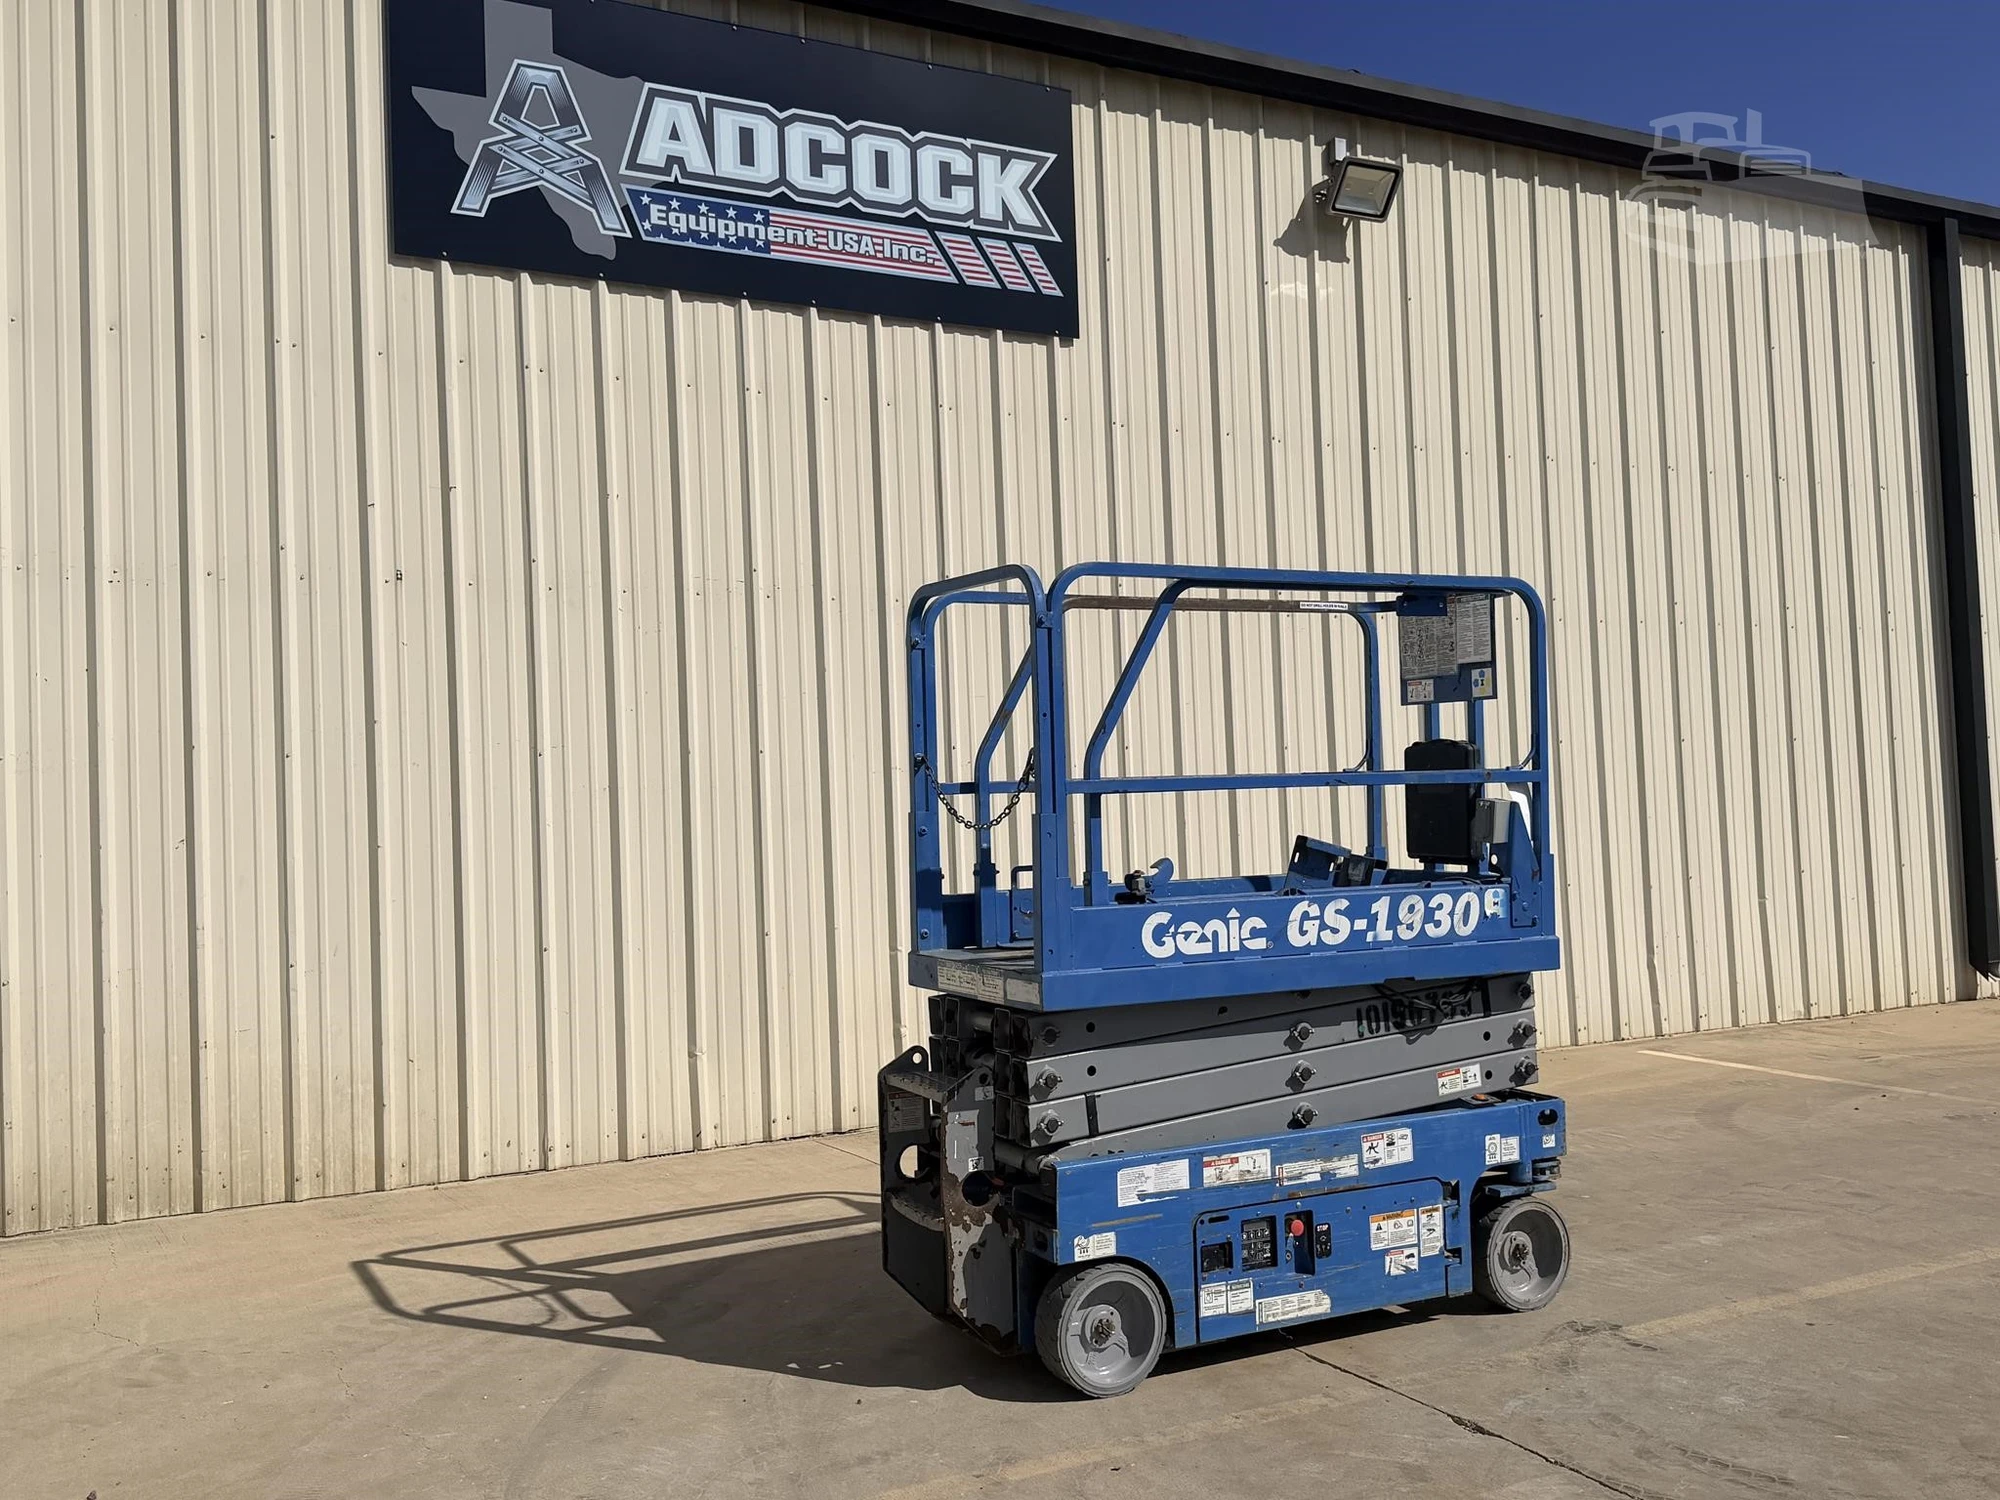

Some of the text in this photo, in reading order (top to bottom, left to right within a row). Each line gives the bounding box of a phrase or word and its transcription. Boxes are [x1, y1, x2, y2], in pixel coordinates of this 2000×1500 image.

[630, 90, 1052, 234] ADCOCK
[649, 202, 937, 266] Equipment USA Inc.
[1286, 892, 1481, 948] GS-1930
[1316, 1224, 1329, 1232] STOP
